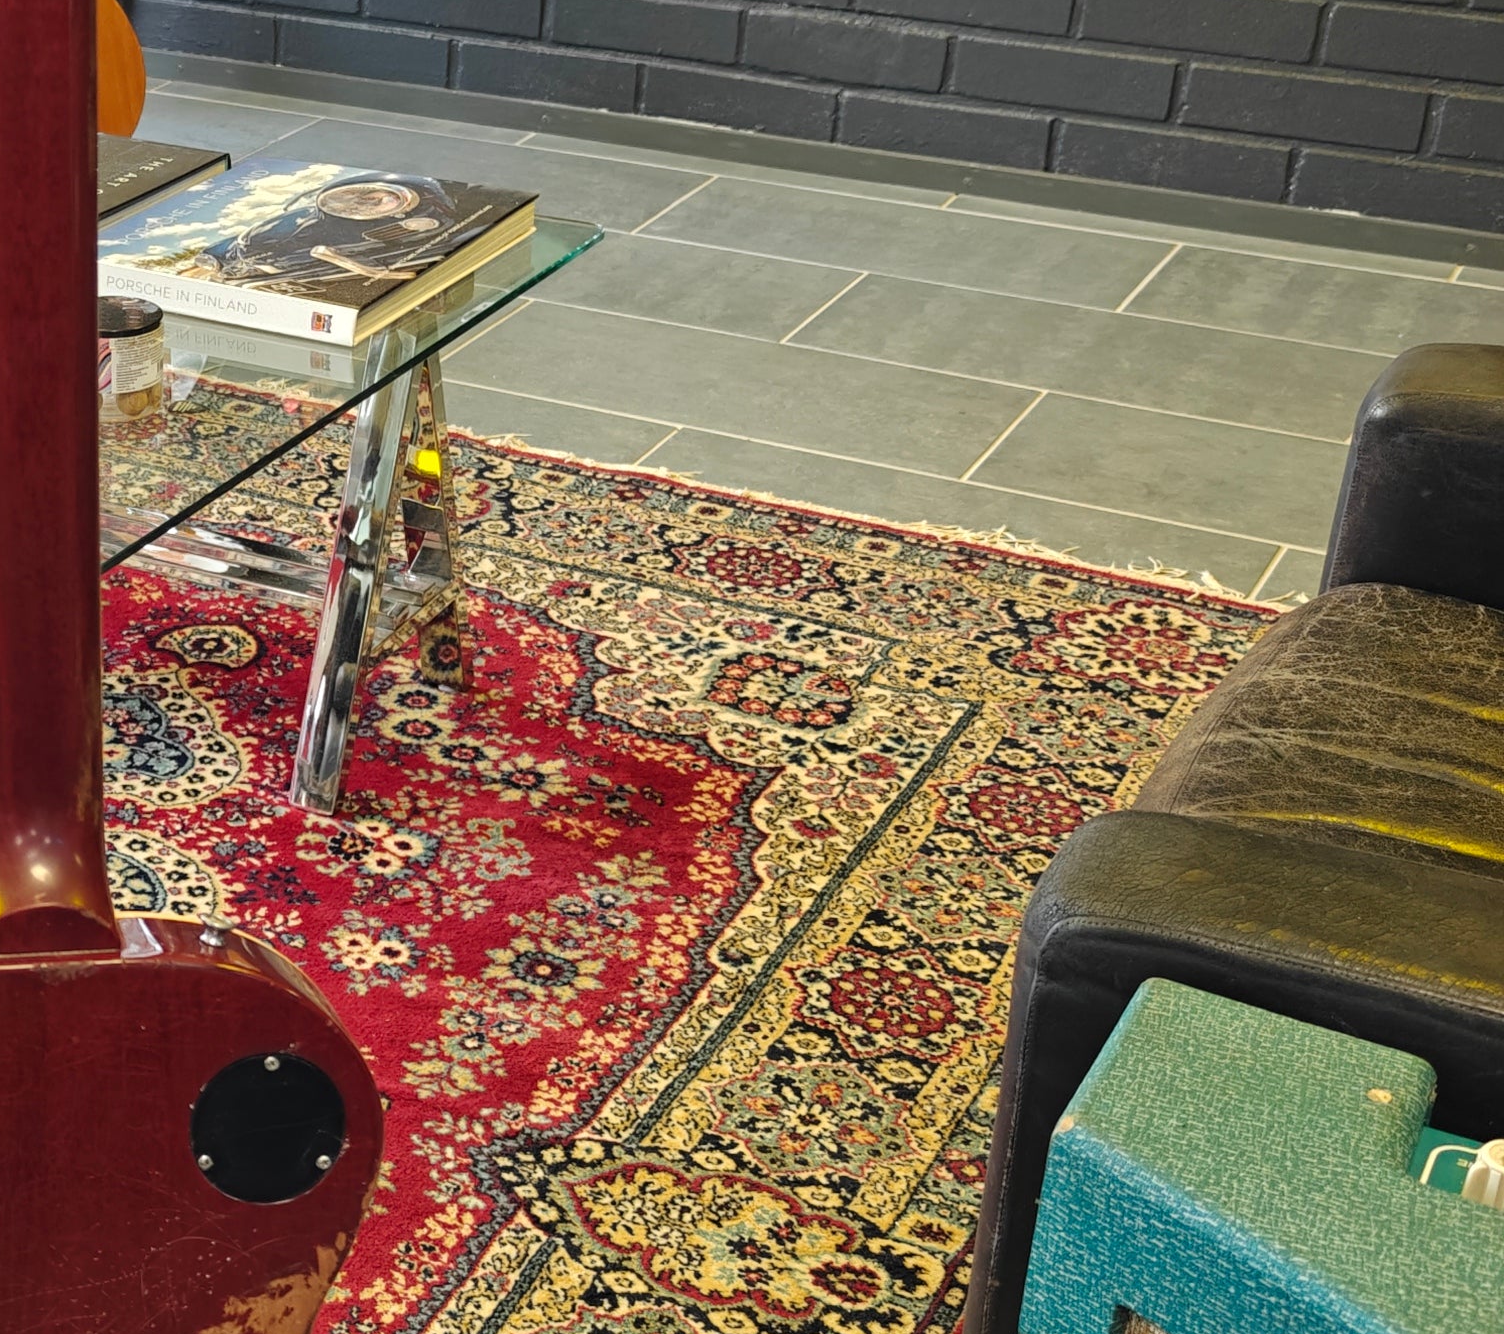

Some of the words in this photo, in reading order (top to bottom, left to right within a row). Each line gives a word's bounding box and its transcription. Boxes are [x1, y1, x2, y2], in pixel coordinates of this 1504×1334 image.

[139, 157, 175, 172] THE
[107, 172, 138, 188] ART
[119, 203, 193, 246] PORSCHE
[186, 196, 211, 210] IN
[203, 169, 270, 202] FINLAND
[105, 274, 172, 300] PORSCHE
[176, 289, 191, 303] IN
[194, 292, 258, 316] FINLAND
